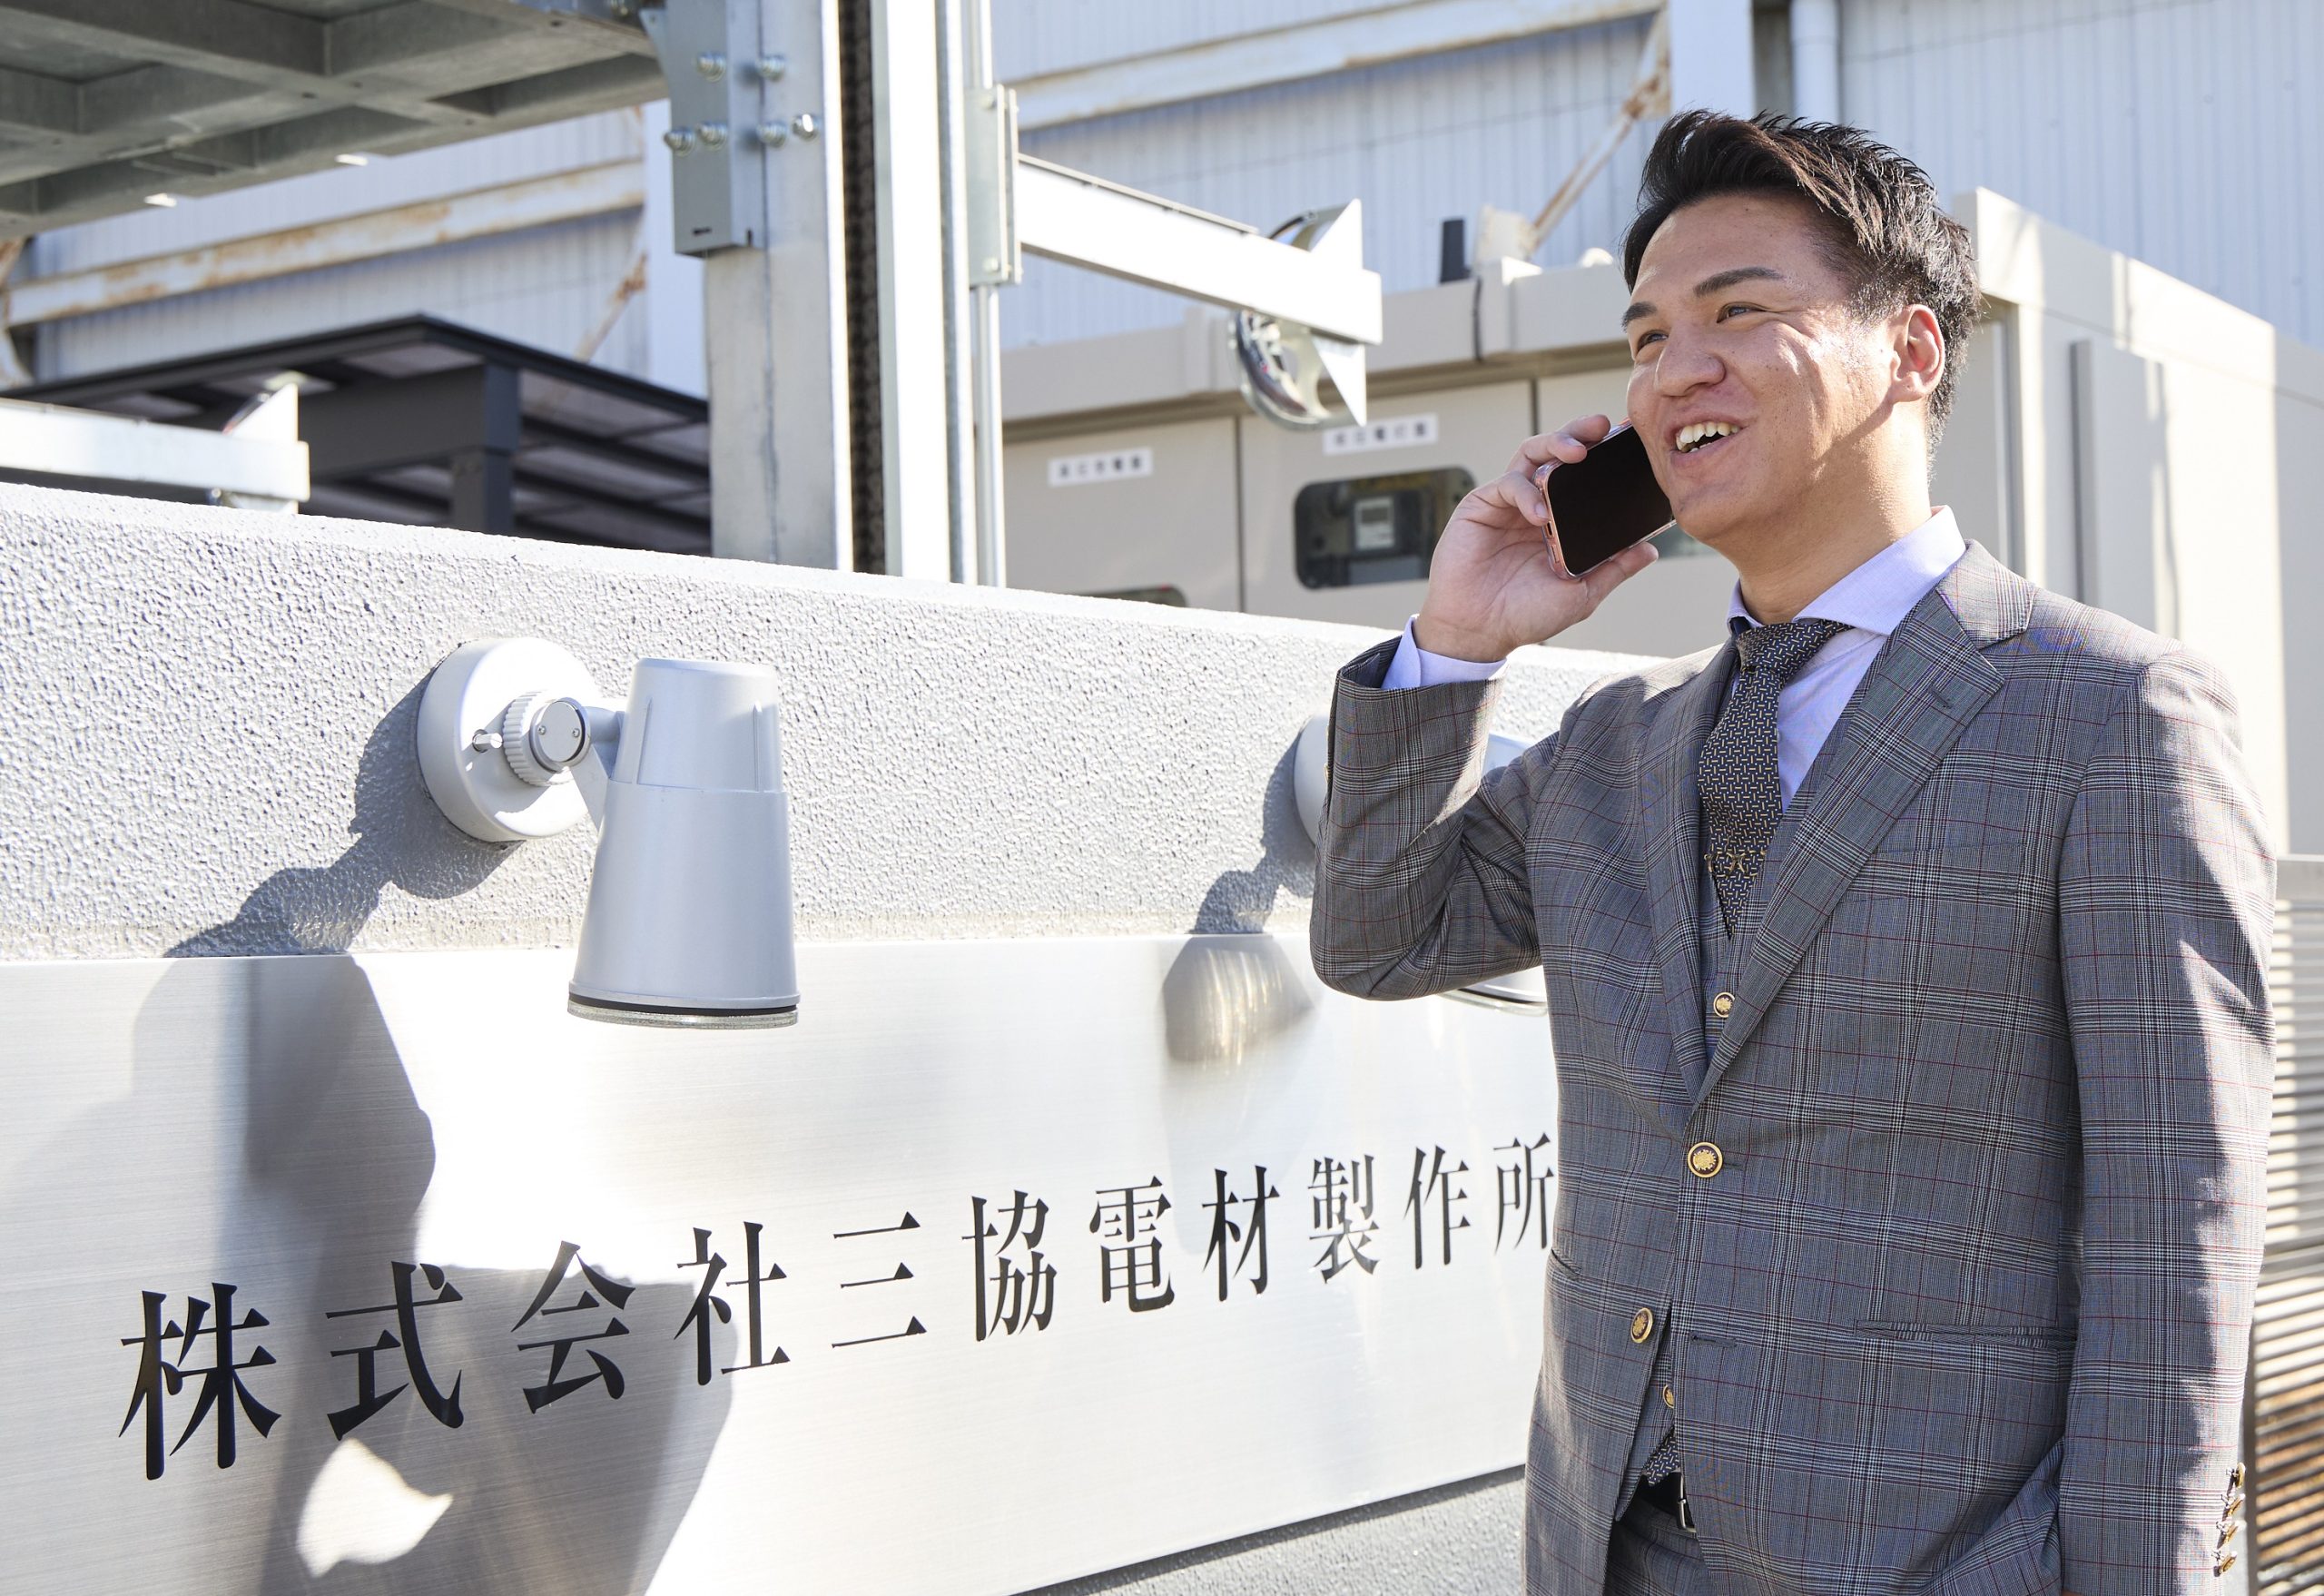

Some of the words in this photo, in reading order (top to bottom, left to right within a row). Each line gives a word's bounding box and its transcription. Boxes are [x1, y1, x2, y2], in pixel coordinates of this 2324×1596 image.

[118, 1132, 1554, 1481] 株式会社三協電材製作所
